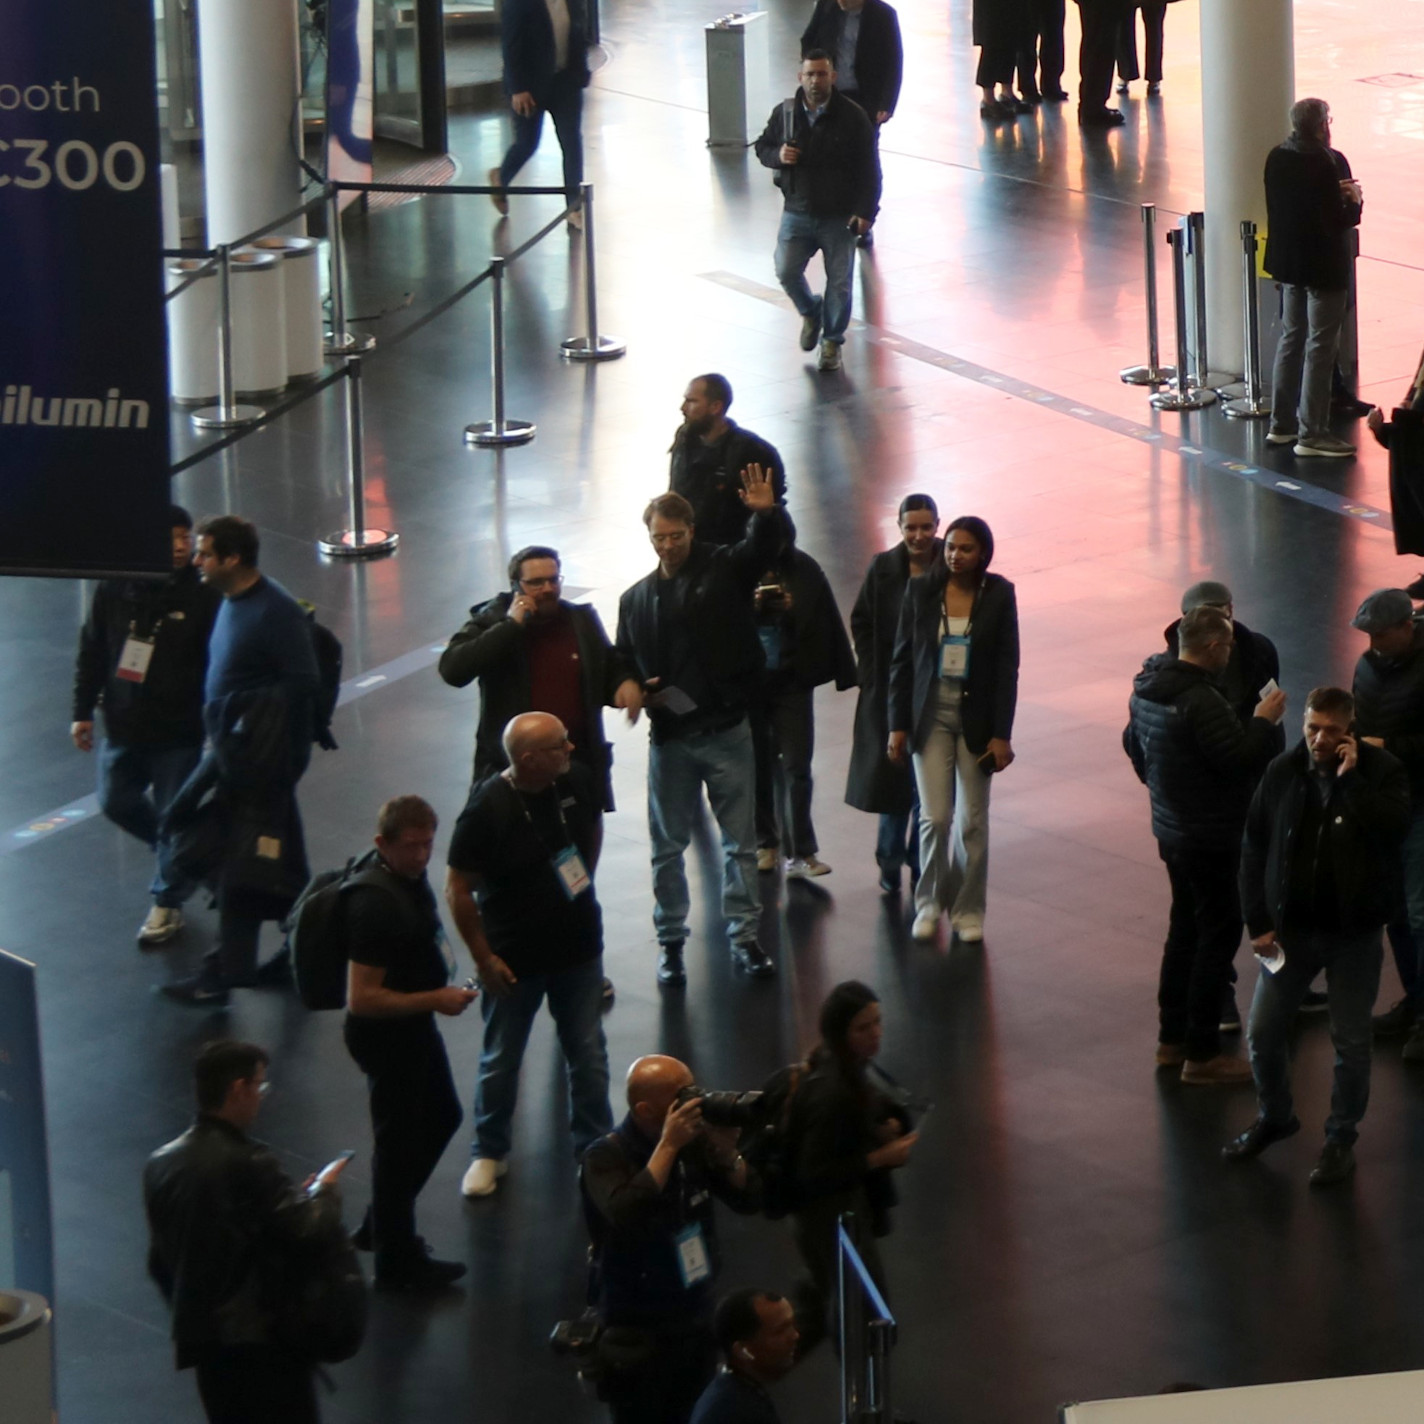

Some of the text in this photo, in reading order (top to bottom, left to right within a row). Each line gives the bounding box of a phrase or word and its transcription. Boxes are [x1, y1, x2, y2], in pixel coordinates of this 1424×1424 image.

[0, 76, 100, 112] ooth
[0, 139, 146, 191] 300
[0, 384, 150, 429] ilumin
